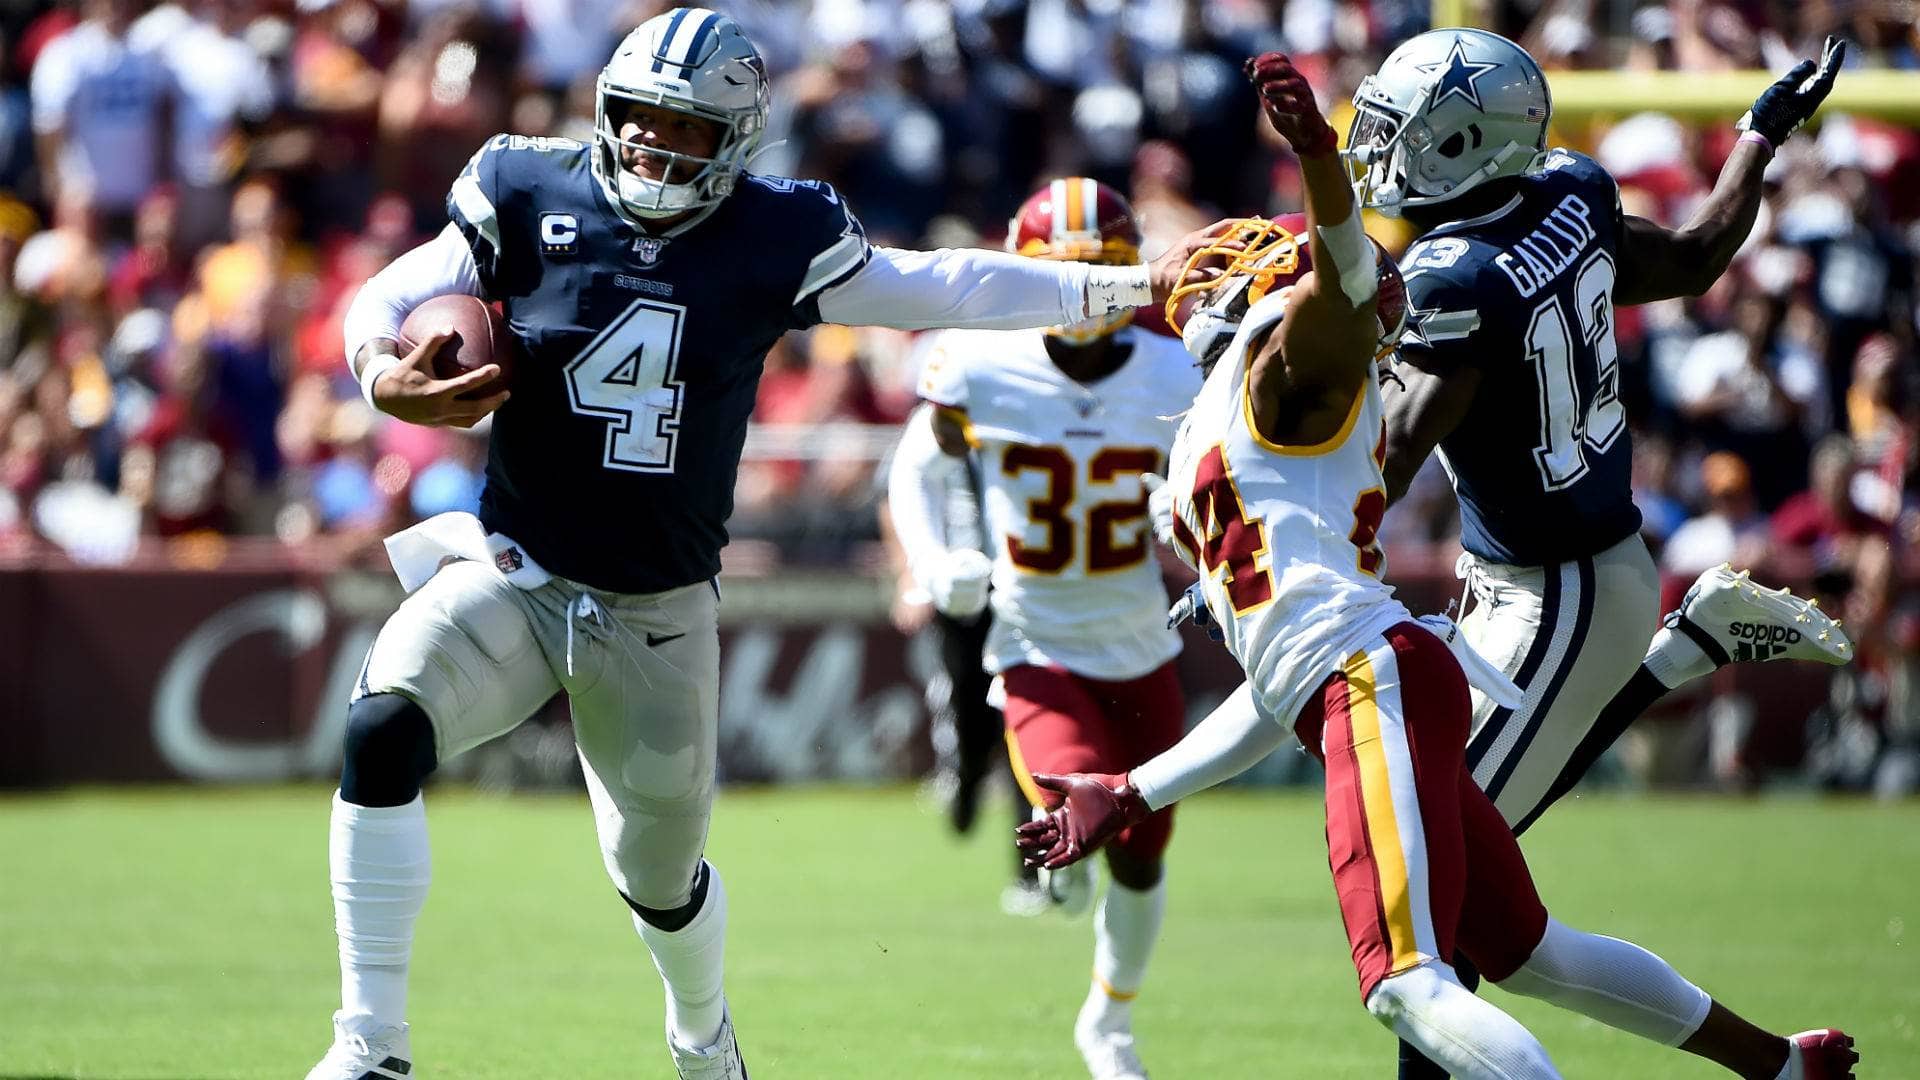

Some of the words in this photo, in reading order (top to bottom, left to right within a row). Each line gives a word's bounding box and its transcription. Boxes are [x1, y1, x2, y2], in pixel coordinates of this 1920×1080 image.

[541, 214, 577, 244] C
[1398, 237, 1470, 269] 13
[1495, 194, 1597, 298] GALLUP
[614, 274, 674, 297] COWBOYS
[563, 298, 687, 474] 4
[1524, 248, 1626, 493] 13
[1001, 443, 1164, 575] 32
[1728, 621, 1801, 645] adidas
